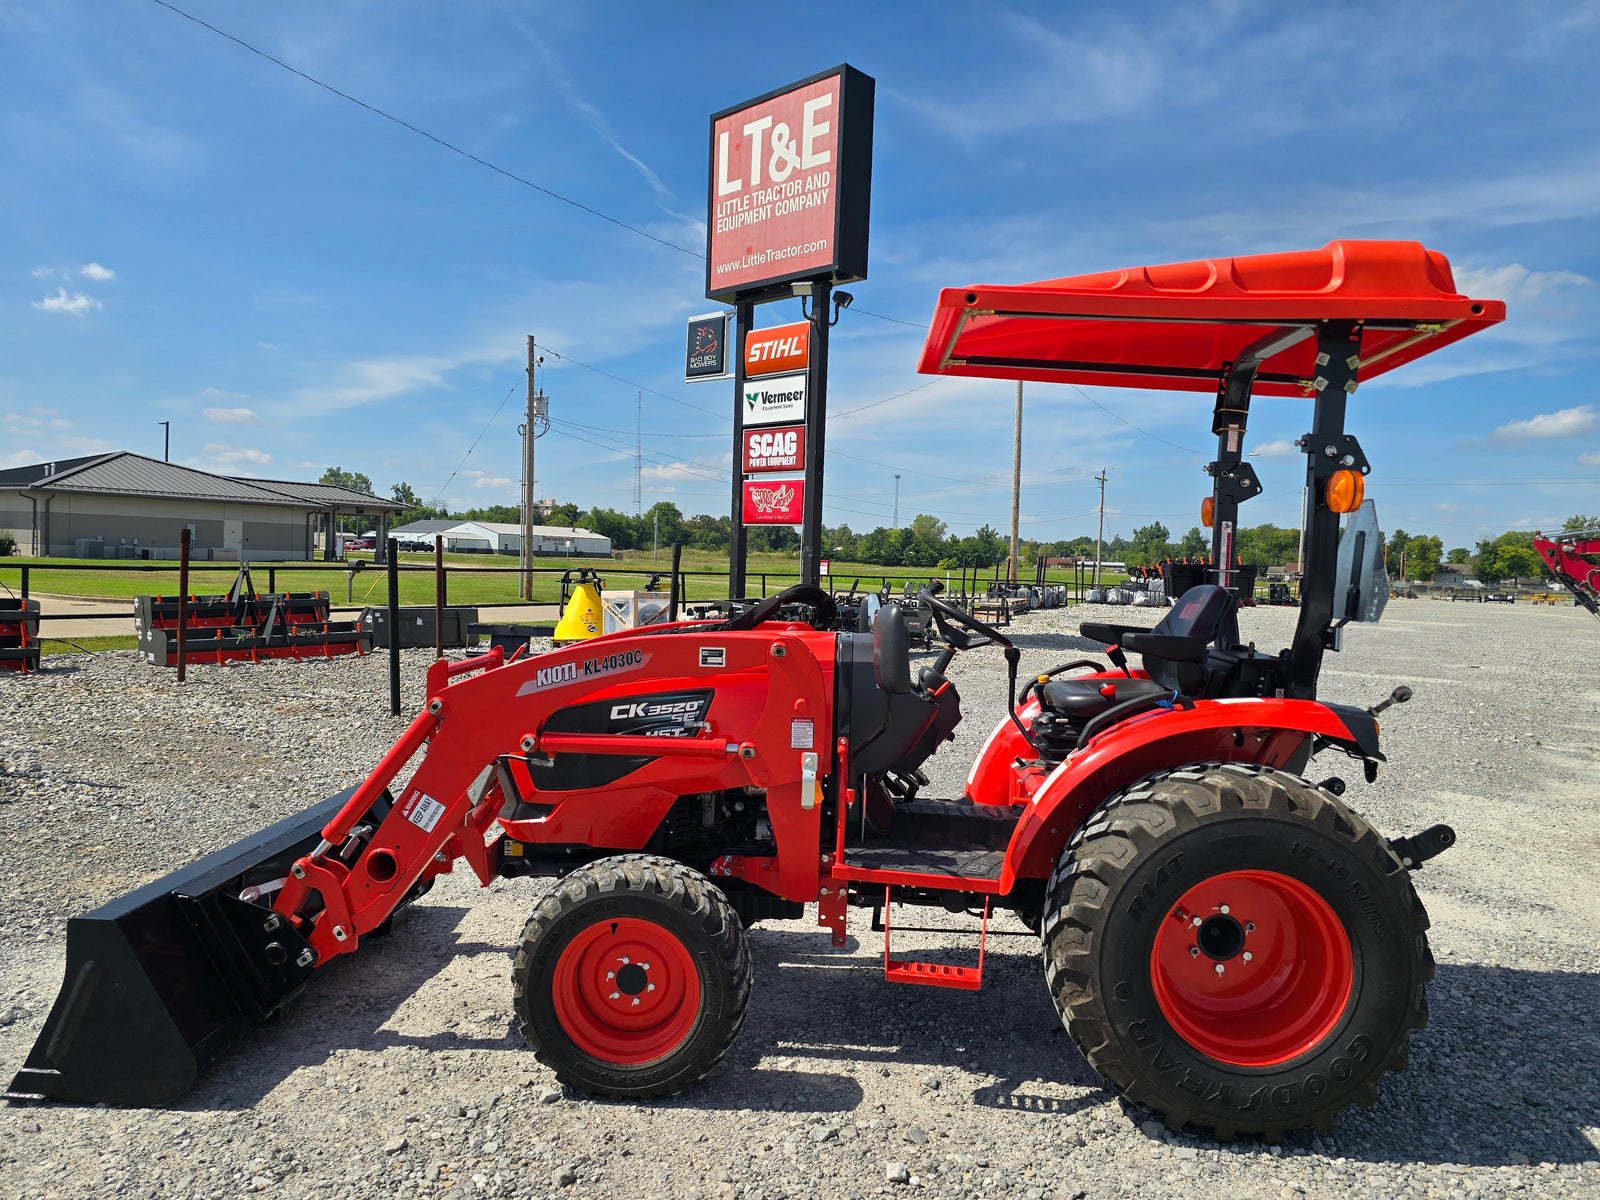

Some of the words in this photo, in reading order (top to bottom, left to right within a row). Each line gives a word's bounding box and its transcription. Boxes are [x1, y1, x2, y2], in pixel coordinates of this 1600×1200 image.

[718, 92, 832, 197] LT&E
[717, 194, 749, 218] LITTLE
[752, 180, 802, 206] TRACTOR
[805, 171, 830, 192] AND
[717, 204, 772, 233] EQUIPMENT
[775, 188, 829, 216] COMPANY
[717, 239, 827, 274] www.LittleTractor.com
[690, 356, 703, 364] BAD
[748, 334, 802, 363] STIHL
[690, 359, 717, 369] MOWERS
[761, 391, 804, 404] Vermeer
[749, 432, 797, 457] SCAG
[749, 457, 766, 467] POWER
[768, 455, 796, 466] EQUIPMENT
[536, 661, 577, 688] KIOTI
[584, 649, 643, 676] KL4030C
[670, 711, 696, 723] SE
[412, 810, 424, 825] KEEP
[420, 797, 433, 813] AWAY
